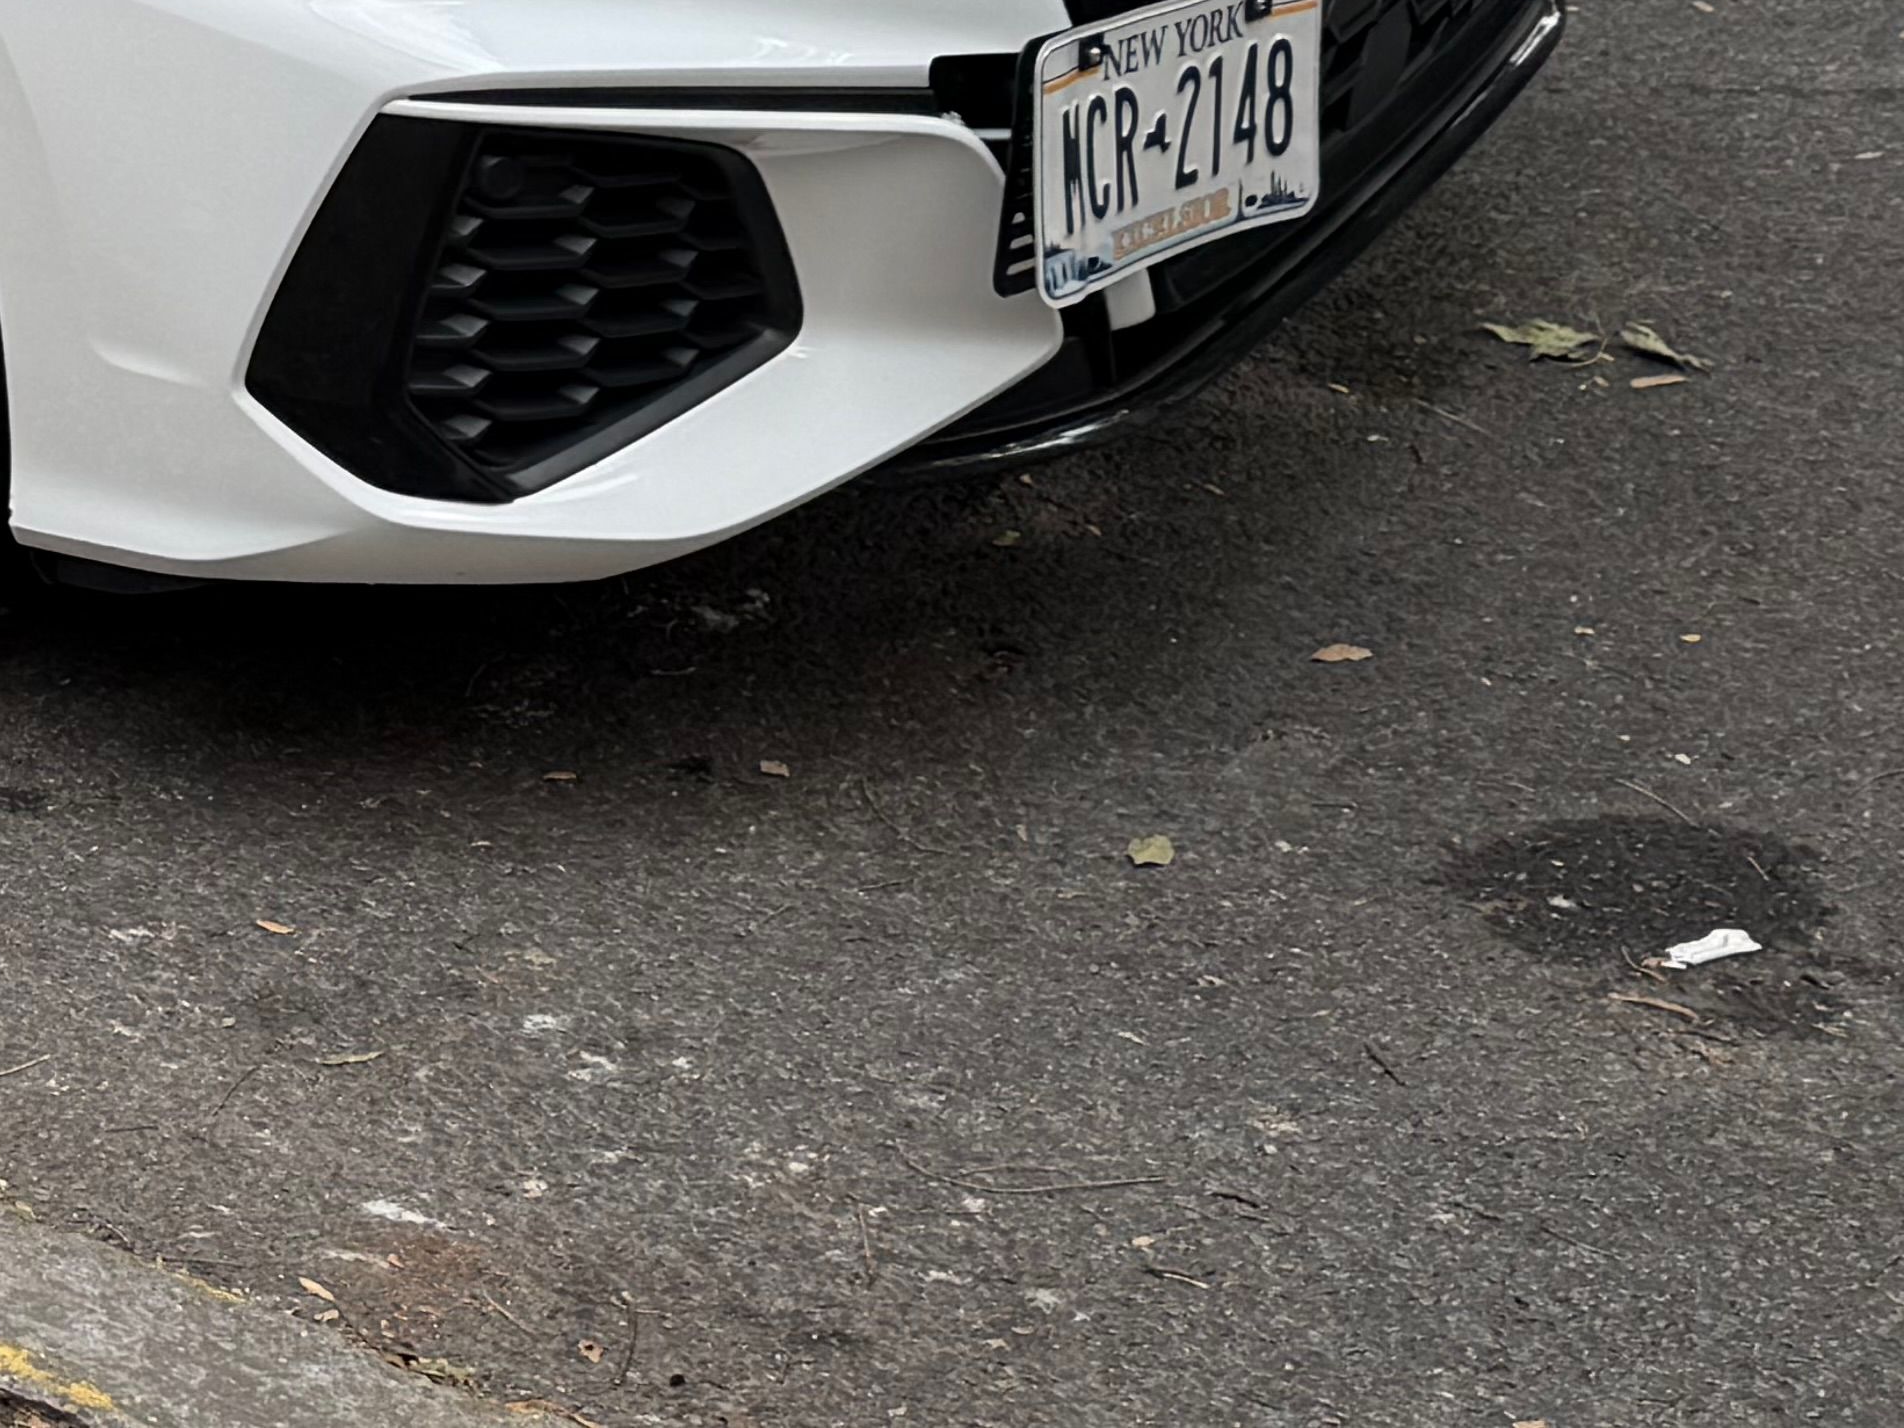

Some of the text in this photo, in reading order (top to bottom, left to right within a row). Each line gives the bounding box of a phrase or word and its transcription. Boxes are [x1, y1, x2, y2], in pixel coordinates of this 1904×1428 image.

[1102, 1, 1245, 82] NEW YORK
[1062, 86, 1139, 236] MCR
[1175, 37, 1294, 191] 2148
